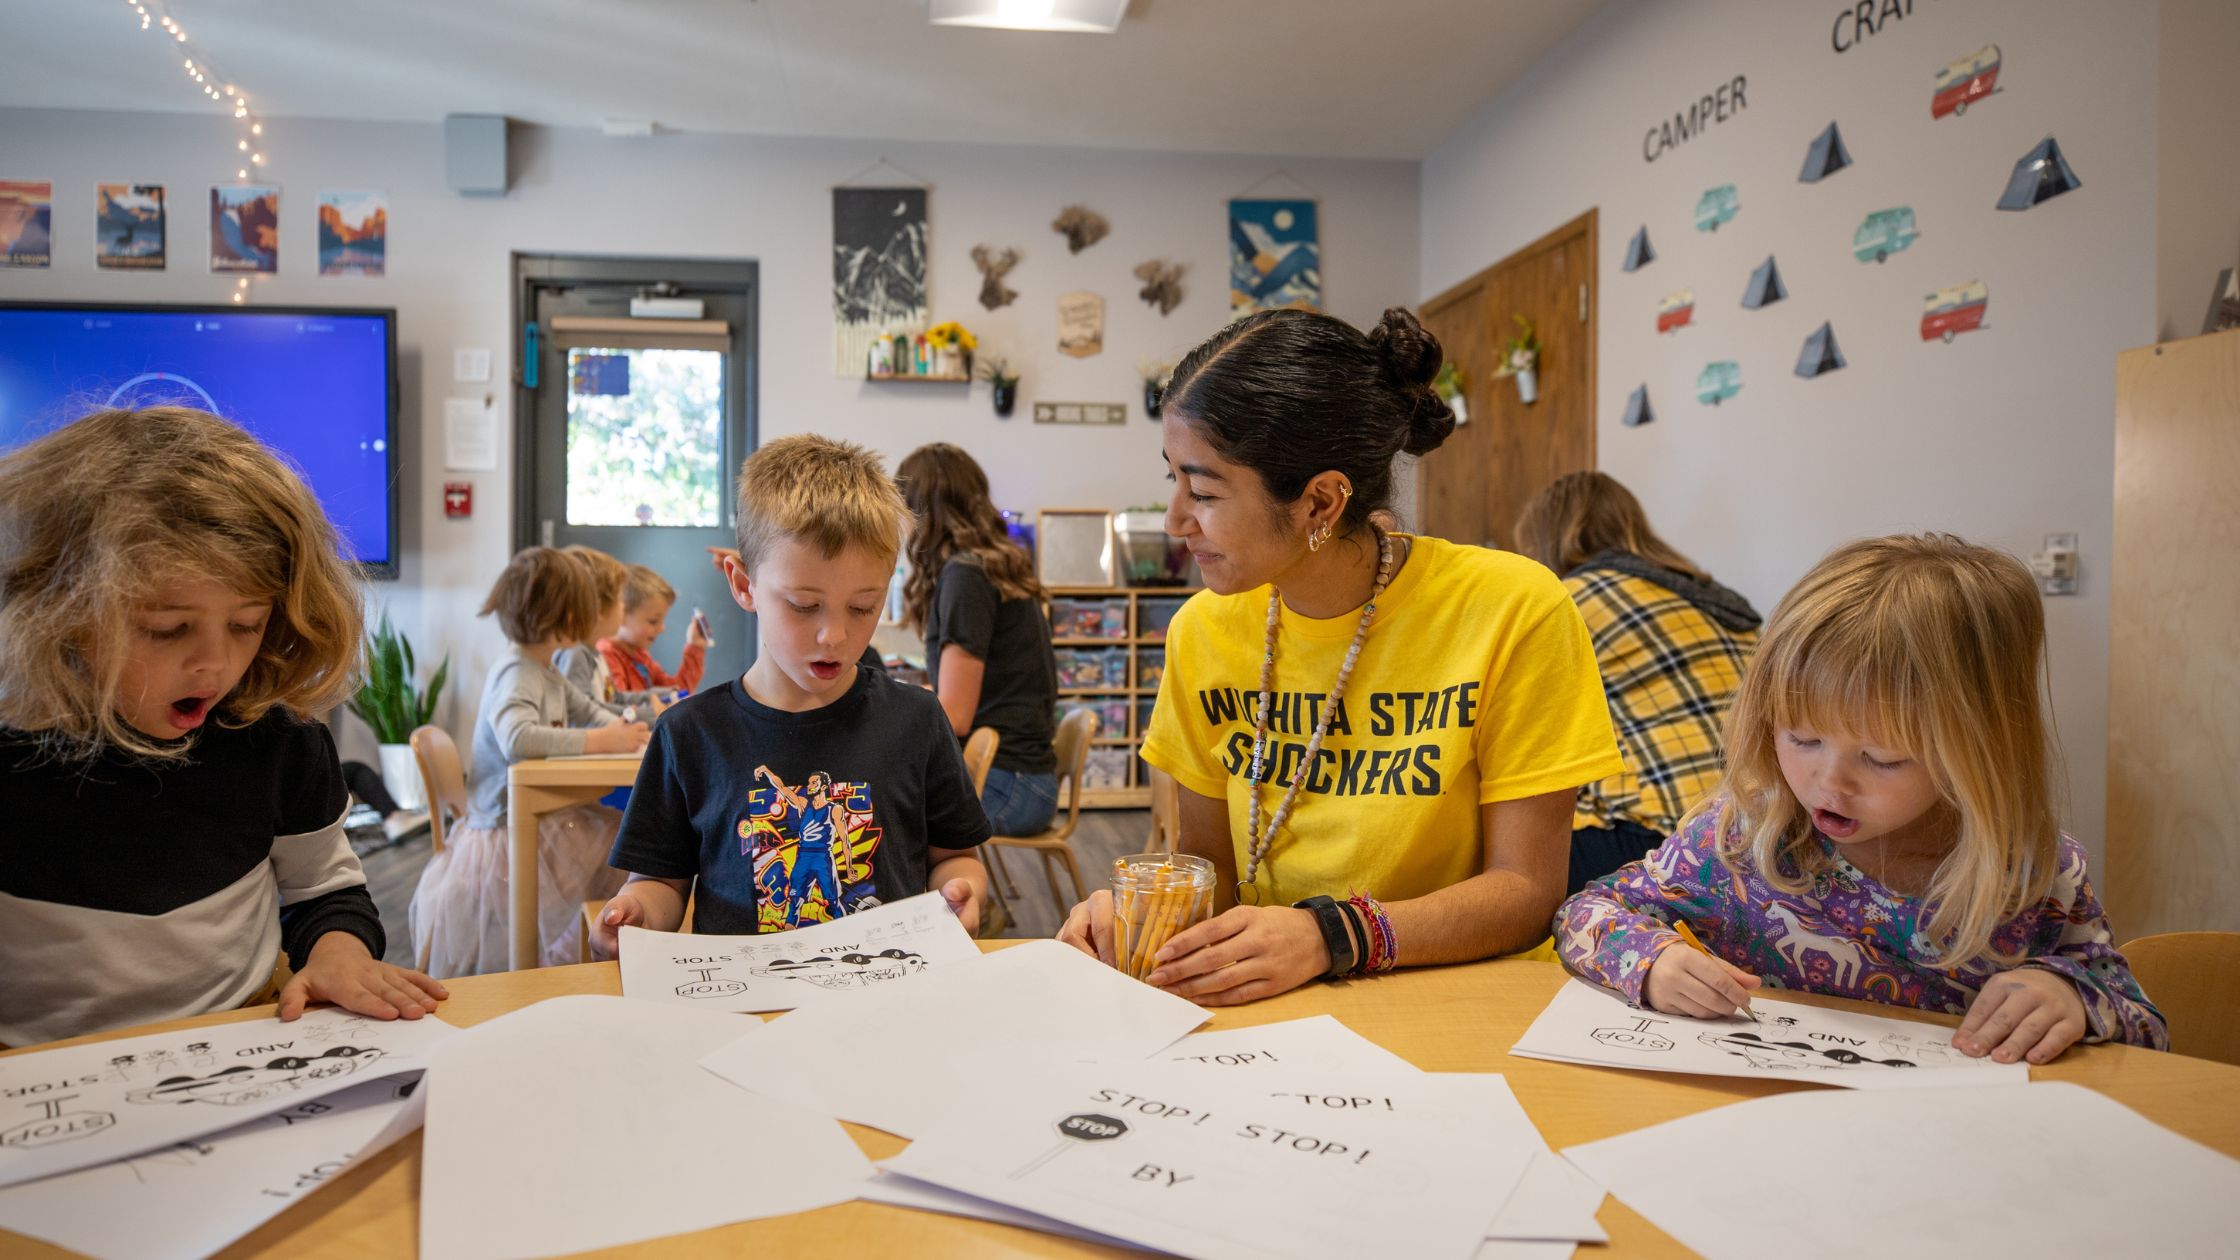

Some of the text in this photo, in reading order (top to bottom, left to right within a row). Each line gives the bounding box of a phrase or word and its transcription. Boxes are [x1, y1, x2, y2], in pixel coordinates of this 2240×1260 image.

[1832, 0, 1912, 53] CRA
[1643, 74, 1747, 163] CAMPER
[1199, 681, 1480, 737] WICHITA STATE
[672, 954, 733, 965] STOP.
[820, 944, 861, 954] AND
[680, 983, 740, 995] STOP
[235, 1040, 295, 1058] AND
[1596, 1030, 1667, 1050] STOP
[1808, 1031, 1868, 1047] AND
[1271, 1092, 1395, 1112] TOP!
[278, 1101, 332, 1126] BY
[8, 1115, 104, 1146] STOP
[1066, 1117, 1120, 1138] STOP
[1089, 1088, 1371, 1165] STOP! STOP!
[1131, 1163, 1195, 1188] BY
